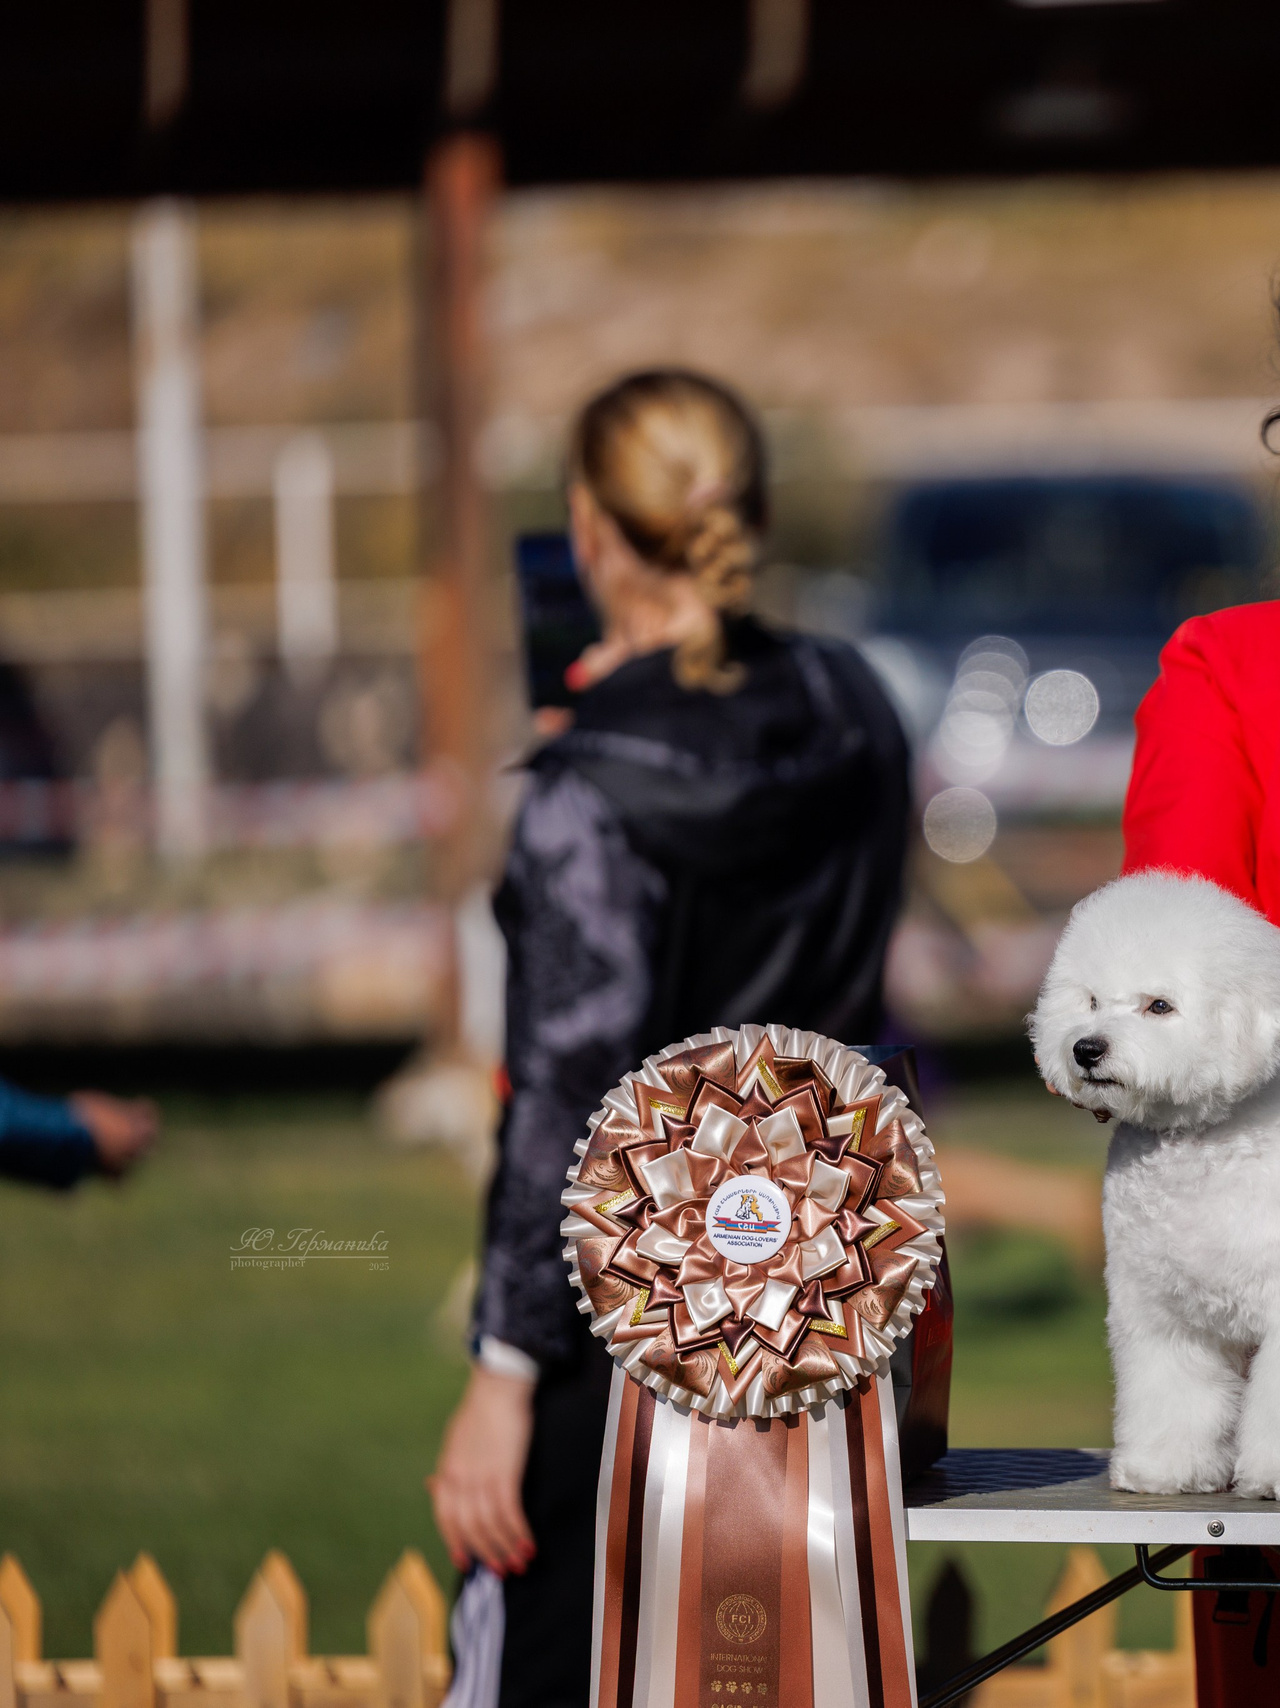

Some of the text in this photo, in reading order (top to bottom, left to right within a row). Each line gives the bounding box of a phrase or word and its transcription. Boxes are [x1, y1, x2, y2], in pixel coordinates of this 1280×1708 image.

[727, 1240, 763, 1248] ASSOCIATION
[731, 1614, 751, 1624] FCI
[716, 1664, 764, 1674] DOG SHOW
